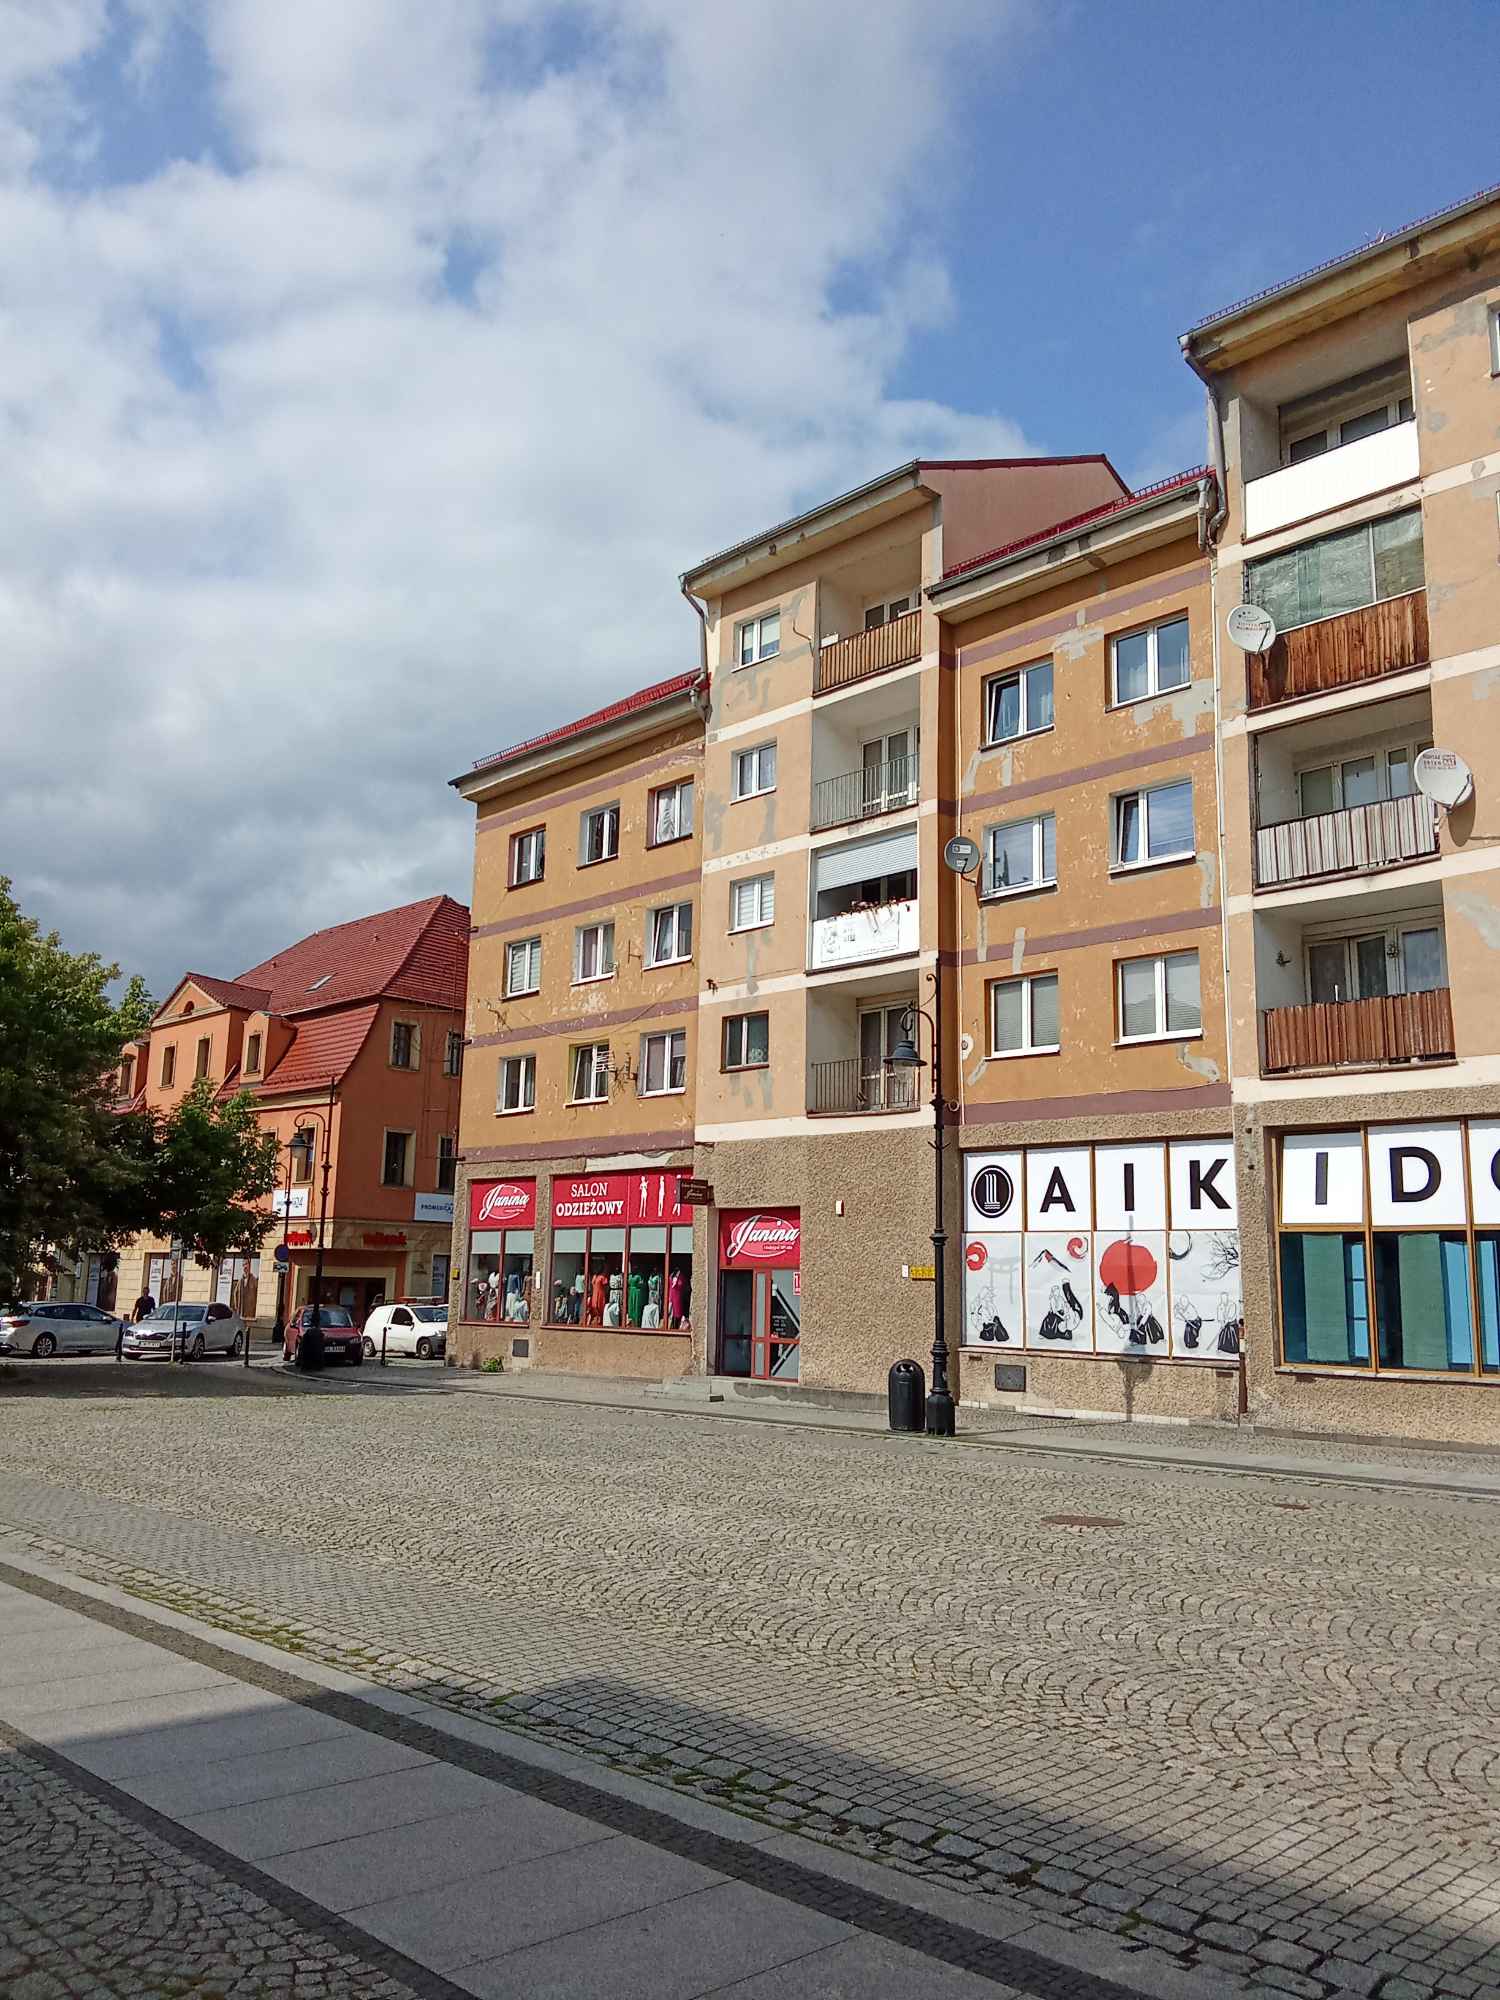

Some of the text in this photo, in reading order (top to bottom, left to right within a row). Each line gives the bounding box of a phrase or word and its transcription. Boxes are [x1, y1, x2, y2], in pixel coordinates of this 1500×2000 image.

[570, 1182, 609, 1198] SALON
[1039, 1146, 1500, 1213] AIKID
[478, 1183, 530, 1221] Janina
[555, 1199, 624, 1217] ODZIEŻOWY
[726, 1214, 800, 1258] Janina
